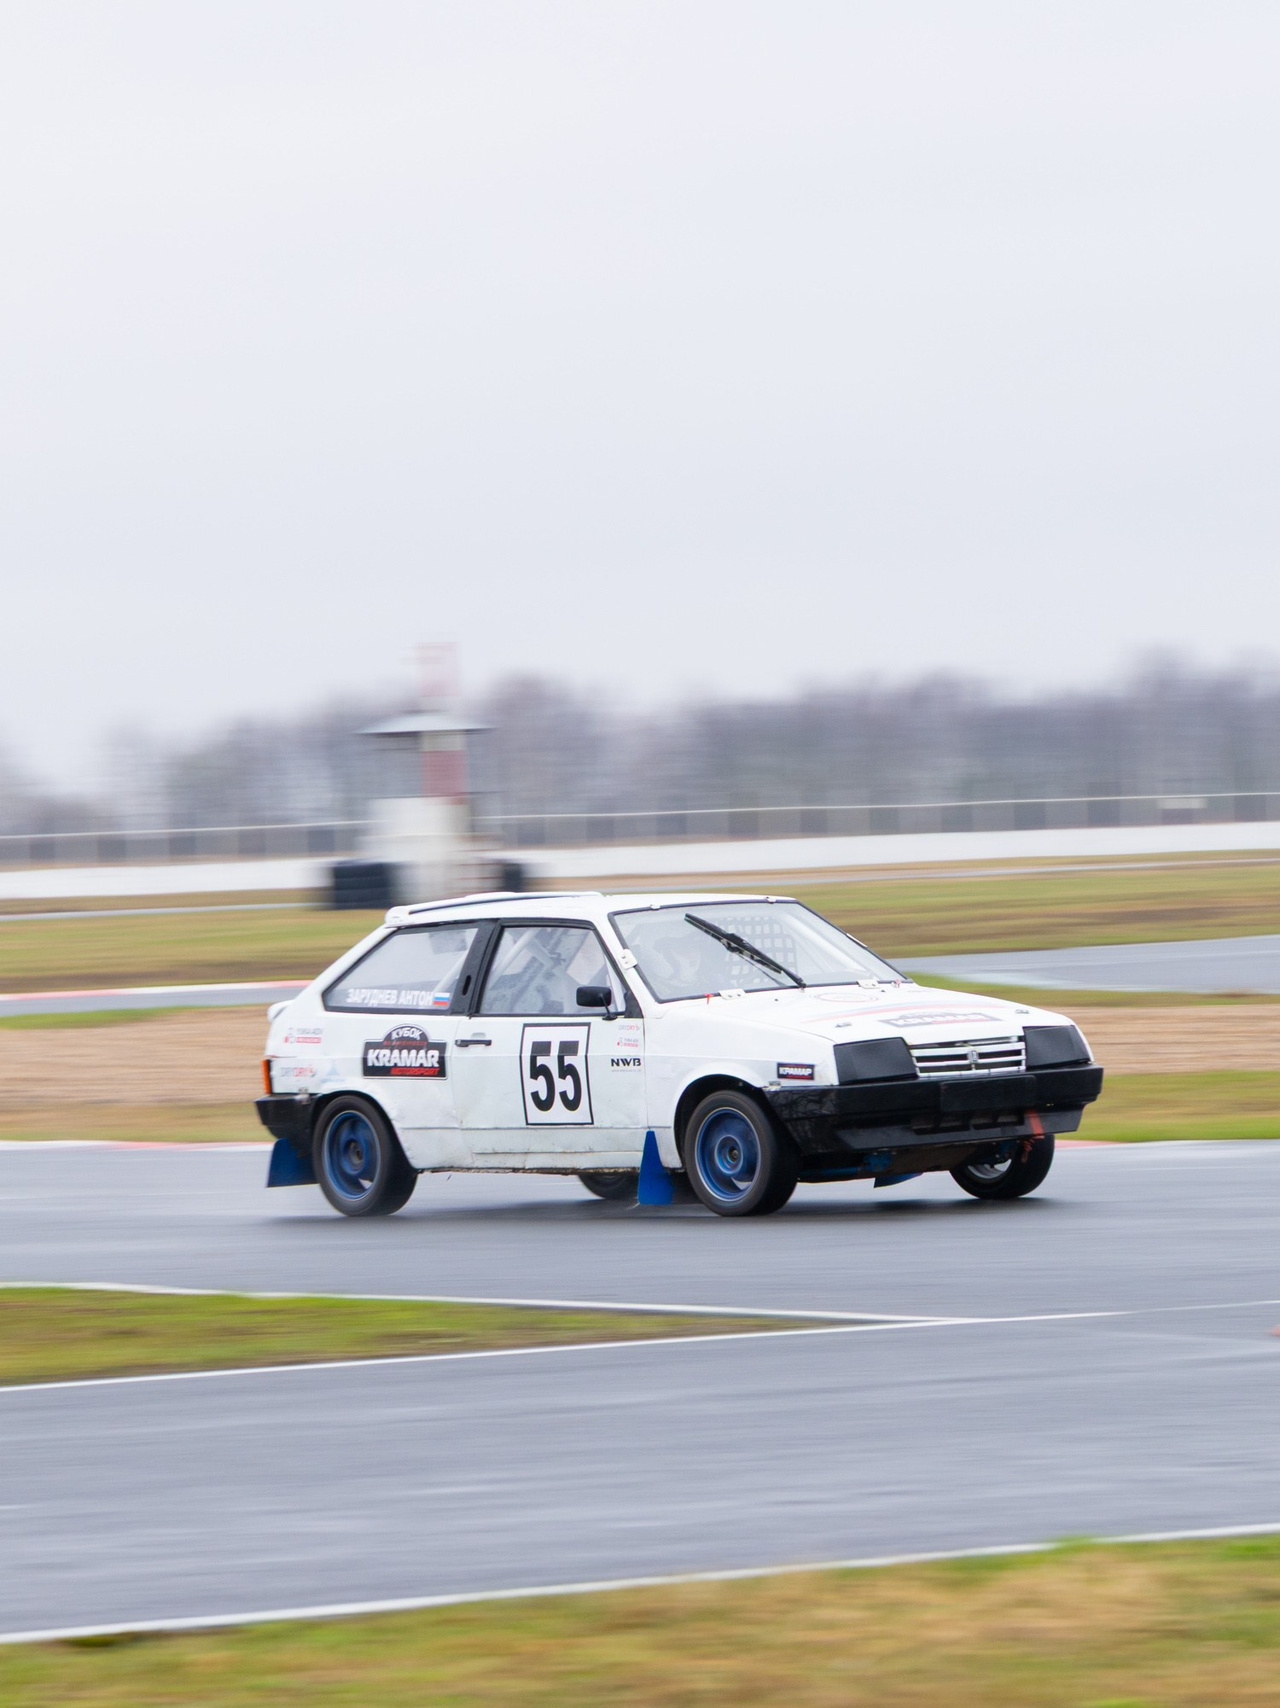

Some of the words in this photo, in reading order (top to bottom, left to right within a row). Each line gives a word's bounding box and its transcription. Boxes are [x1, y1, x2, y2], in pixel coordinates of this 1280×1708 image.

[346, 988, 398, 1006] ЗАРУДНЕВ
[398, 990, 434, 1006] АНТОН
[391, 1027, 423, 1040] КУБОК
[367, 1049, 440, 1067] KRAMAR
[611, 1058, 641, 1067] NWB
[530, 1040, 582, 1112] 55
